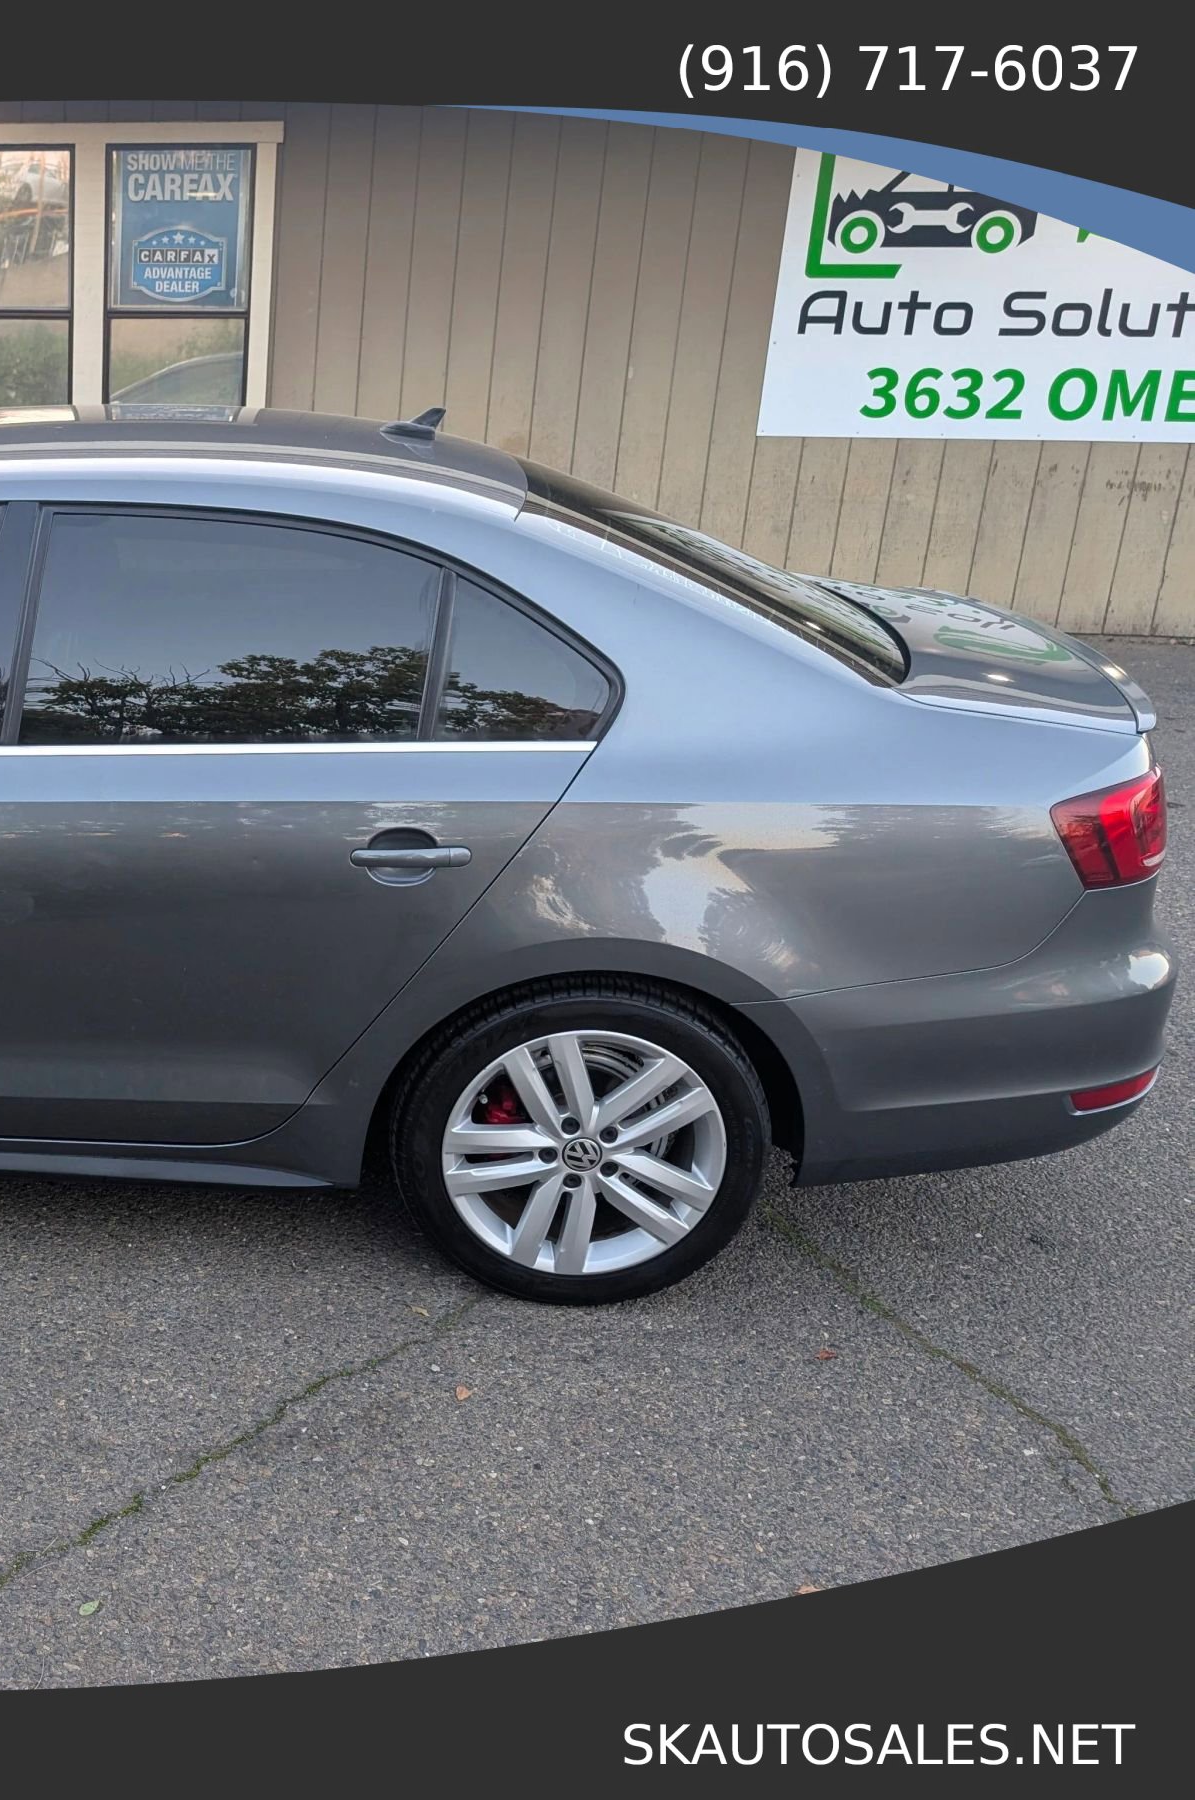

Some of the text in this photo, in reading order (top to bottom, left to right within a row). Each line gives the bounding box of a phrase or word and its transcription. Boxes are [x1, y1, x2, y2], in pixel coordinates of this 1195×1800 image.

[127, 153, 236, 171] SHOW ME THE
[127, 173, 235, 202] CARFAX
[139, 250, 218, 265] CARFAX
[144, 267, 212, 280] ADVANTAGE
[155, 281, 200, 293] DEALER
[797, 290, 974, 336] Auto
[859, 366, 1026, 420] 3632
